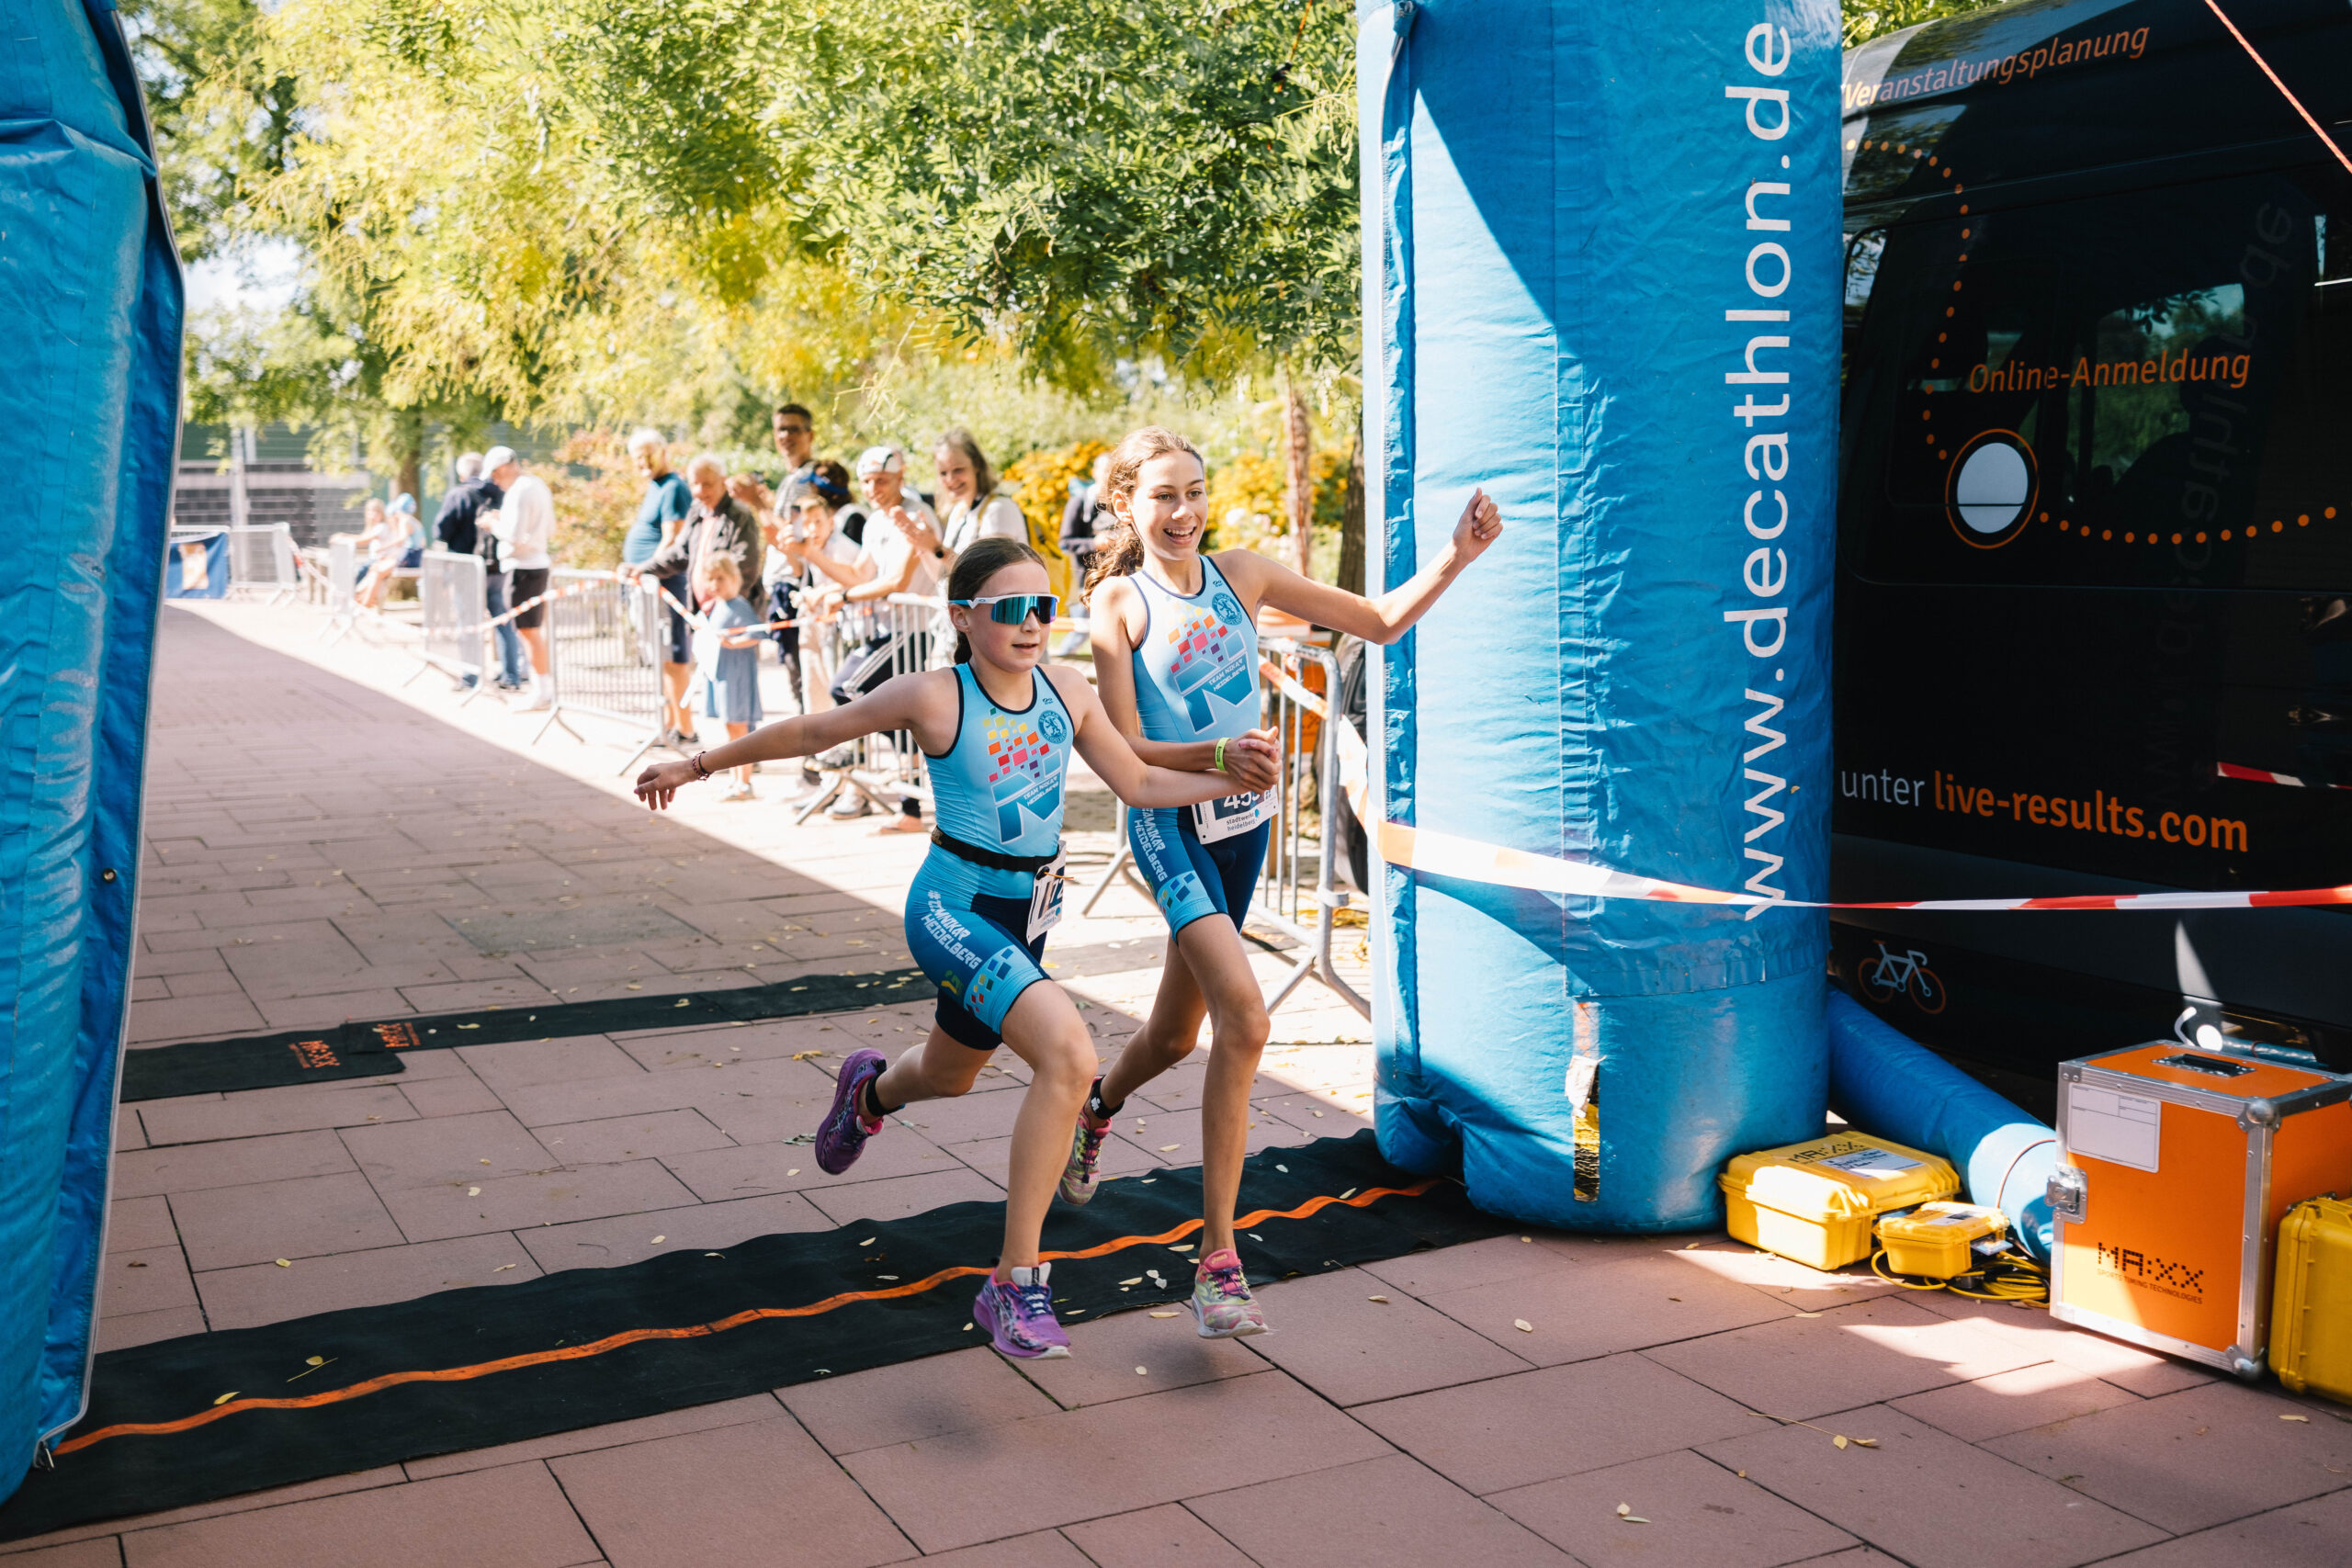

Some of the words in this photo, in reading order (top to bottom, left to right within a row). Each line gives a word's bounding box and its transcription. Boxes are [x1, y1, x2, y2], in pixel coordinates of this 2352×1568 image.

[1844, 26, 2150, 110] Veranstaltungsplanung
[1969, 347, 2251, 394] Online-Anmeldung
[1724, 22, 1792, 921] www.decathlon.de
[1840, 768, 1926, 807] unter
[1933, 770, 2249, 852] live-results.com
[1134, 819, 1168, 882] HEIDELBERG
[921, 913, 983, 970] HEIDELBERG
[2098, 1242, 2203, 1293] MA:XX
[2149, 1282, 2204, 1304] TECHNOLOGIES
